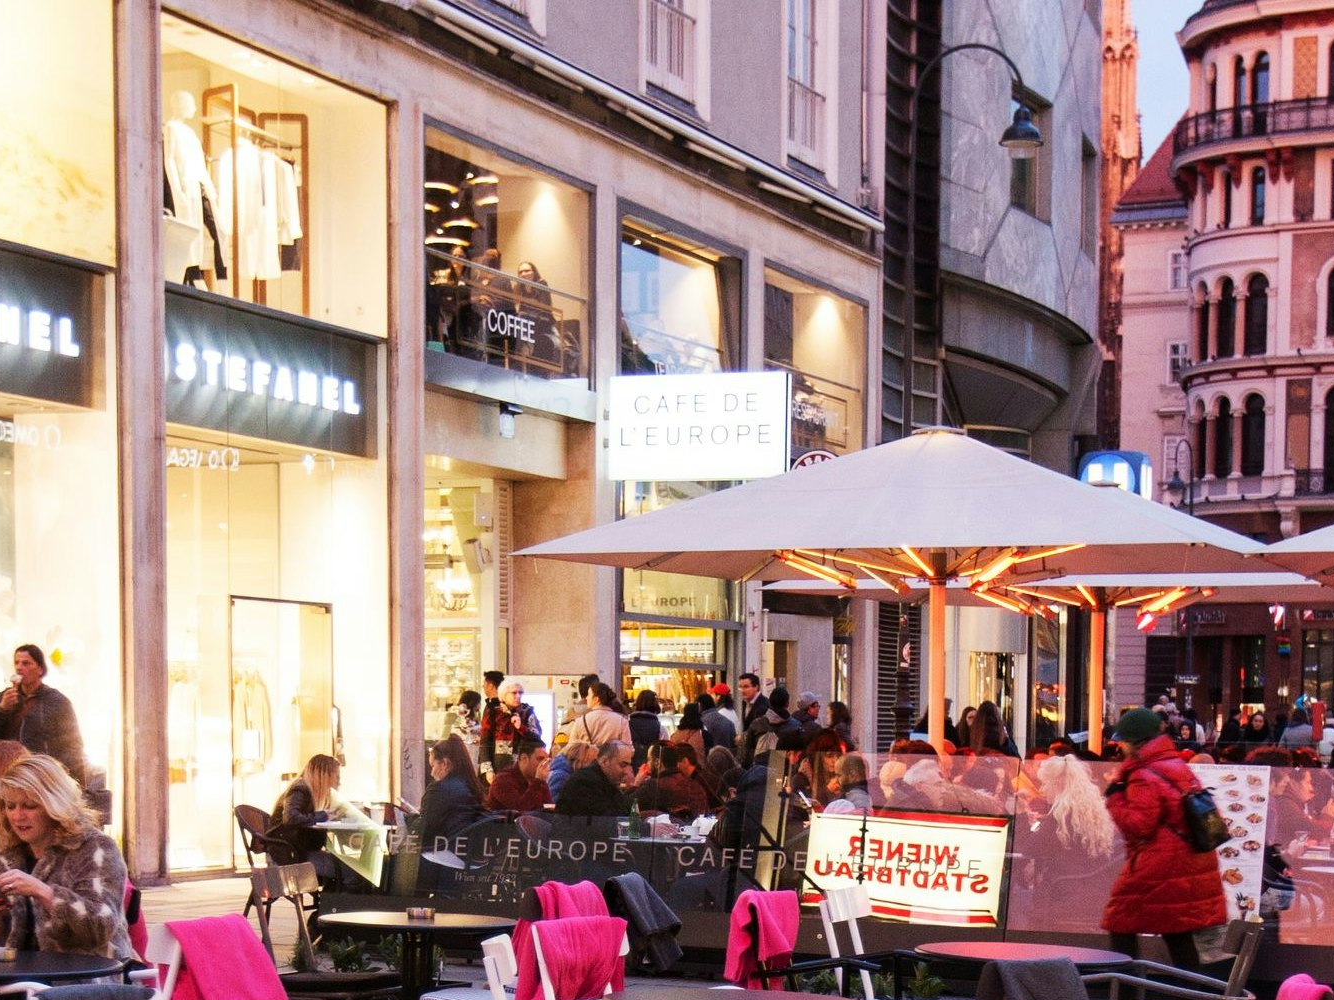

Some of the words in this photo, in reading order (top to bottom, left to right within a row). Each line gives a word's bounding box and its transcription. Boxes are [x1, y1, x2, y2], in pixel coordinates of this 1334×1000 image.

[487, 308, 536, 344] COFFEE
[175, 342, 361, 415] STEFANEL
[634, 394, 706, 415] CAFE
[724, 393, 759, 413] DE
[620, 424, 772, 447] L'EUROPE
[348, 830, 419, 854] CAFÉ
[434, 836, 468, 856] DE
[484, 838, 629, 862] L'EUROPE
[677, 845, 755, 869] CAFÉ
[773, 851, 806, 871] DE
